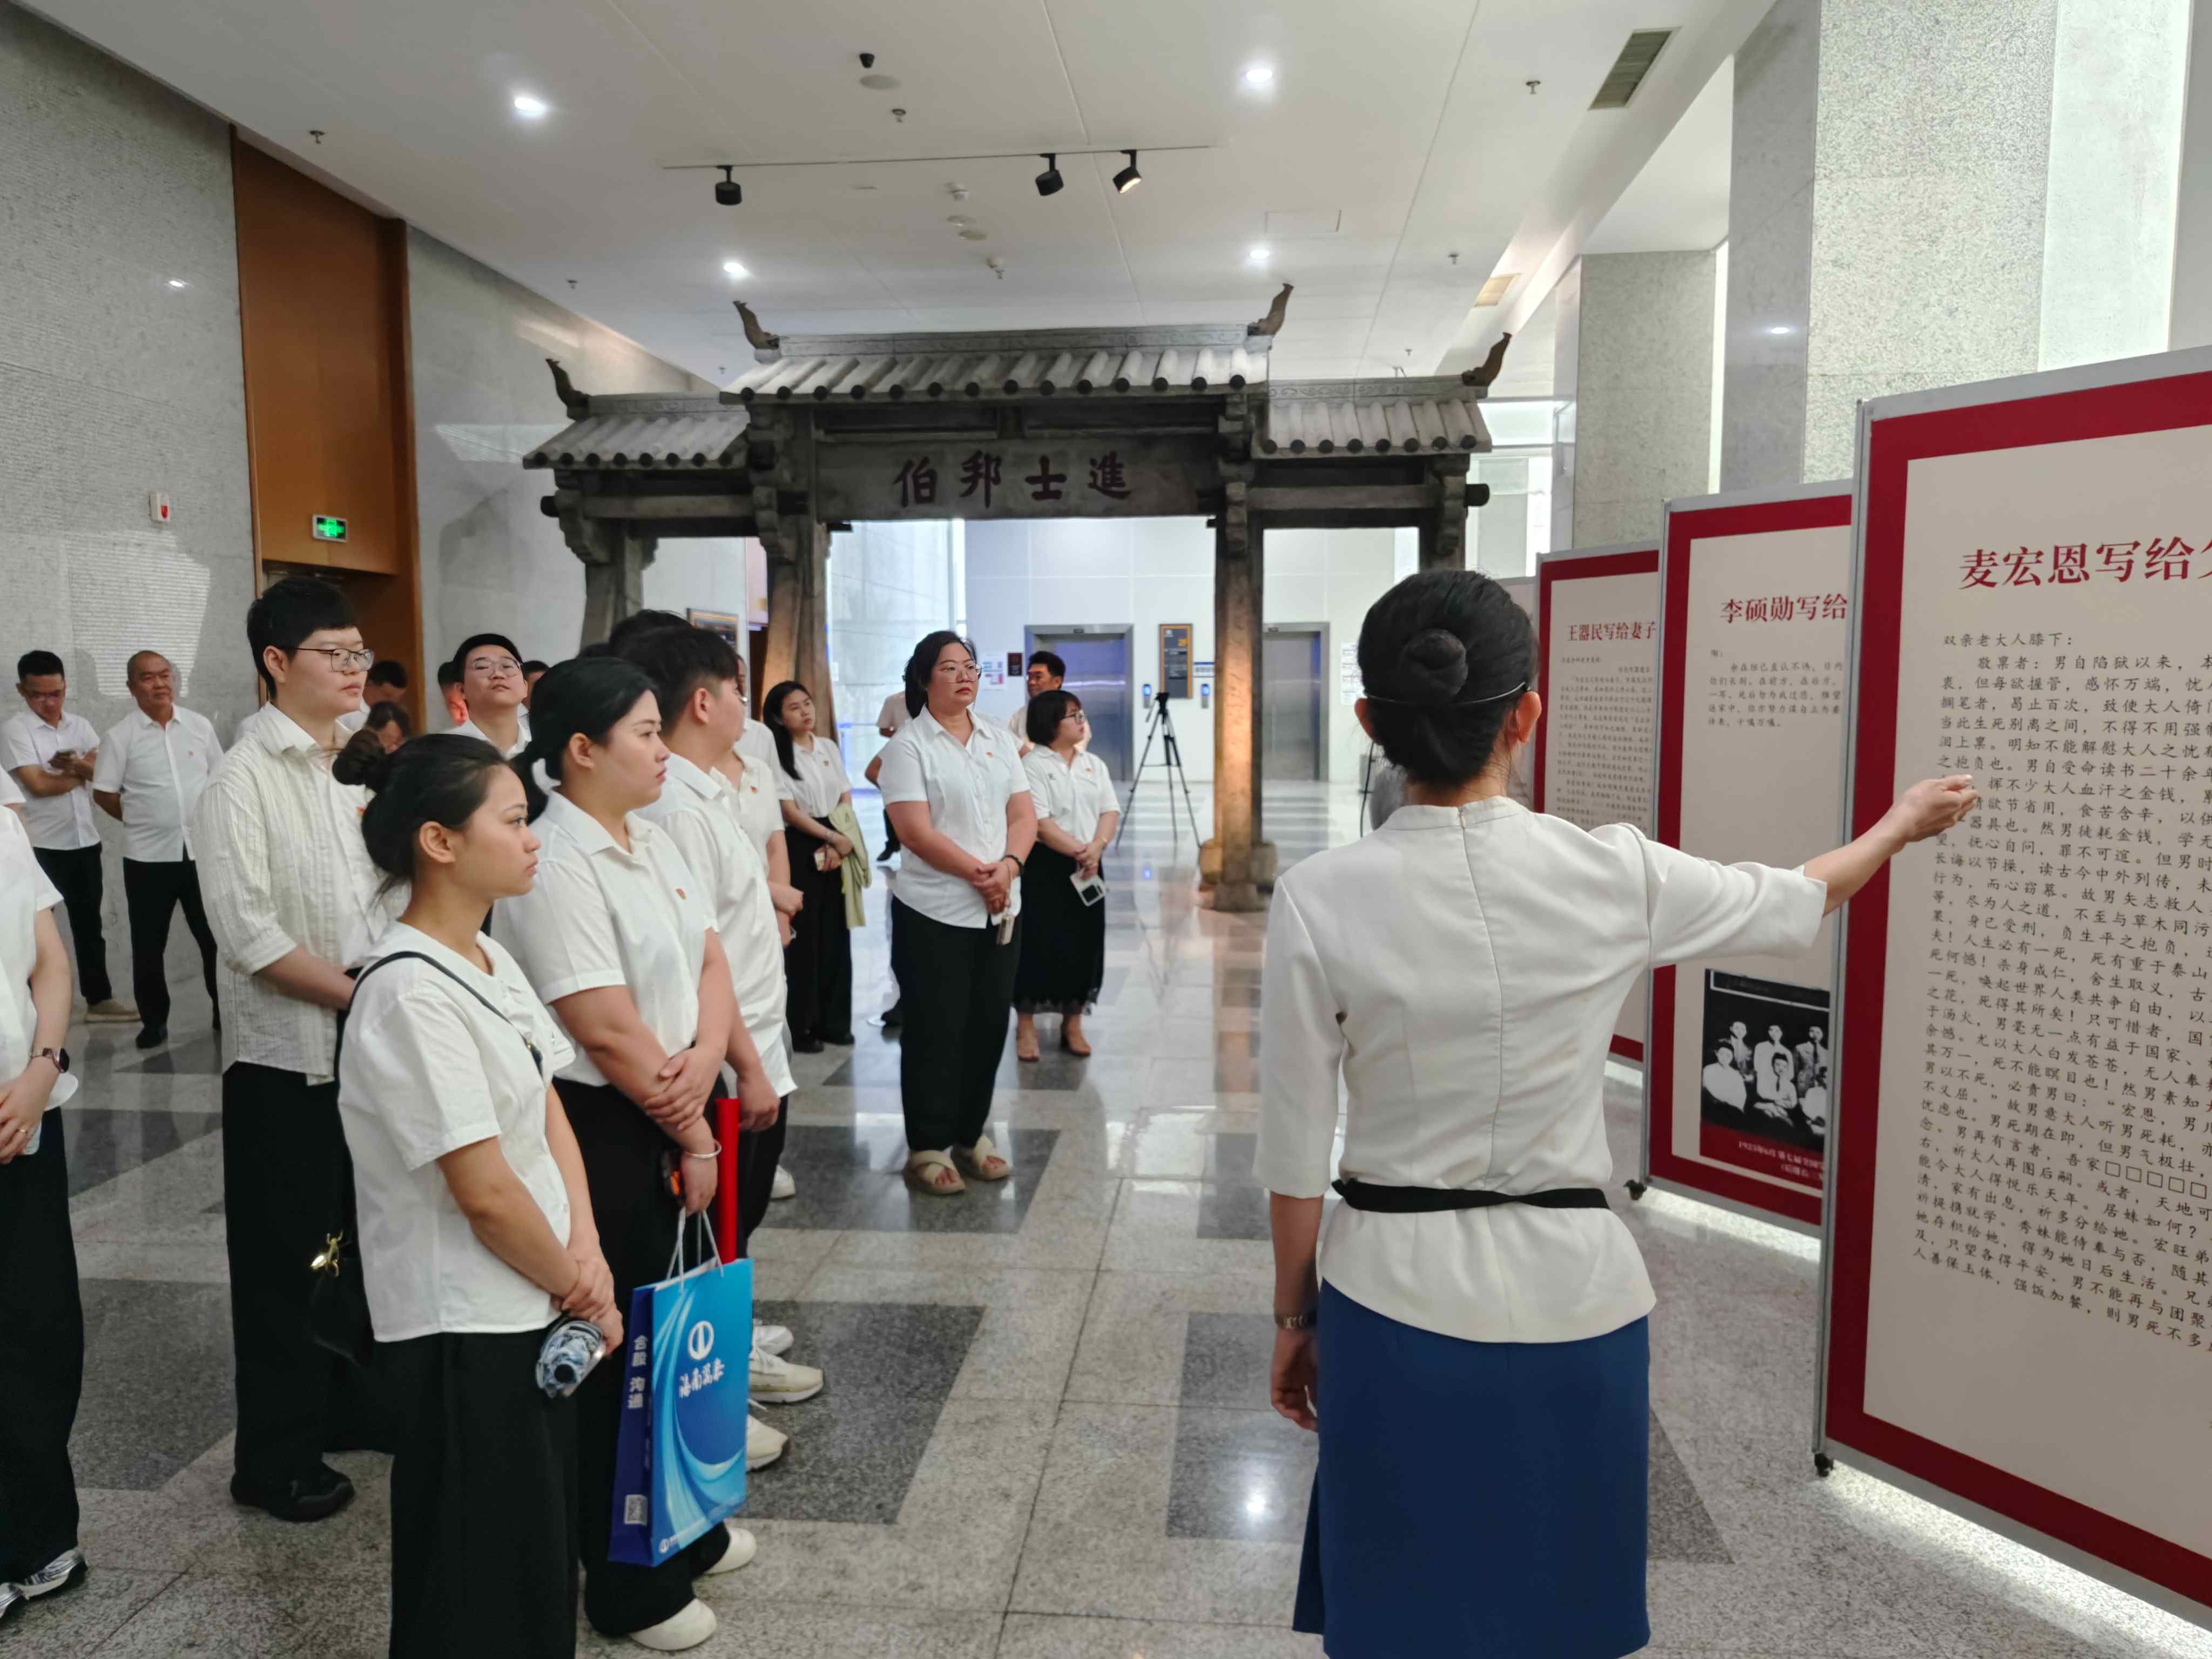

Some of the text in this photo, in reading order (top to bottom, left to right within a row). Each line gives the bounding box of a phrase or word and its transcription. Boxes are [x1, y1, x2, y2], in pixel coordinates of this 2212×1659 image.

[1719, 593, 1848, 624] 李硕勋写给
[1568, 621, 1657, 641] 王器民写给妻子
